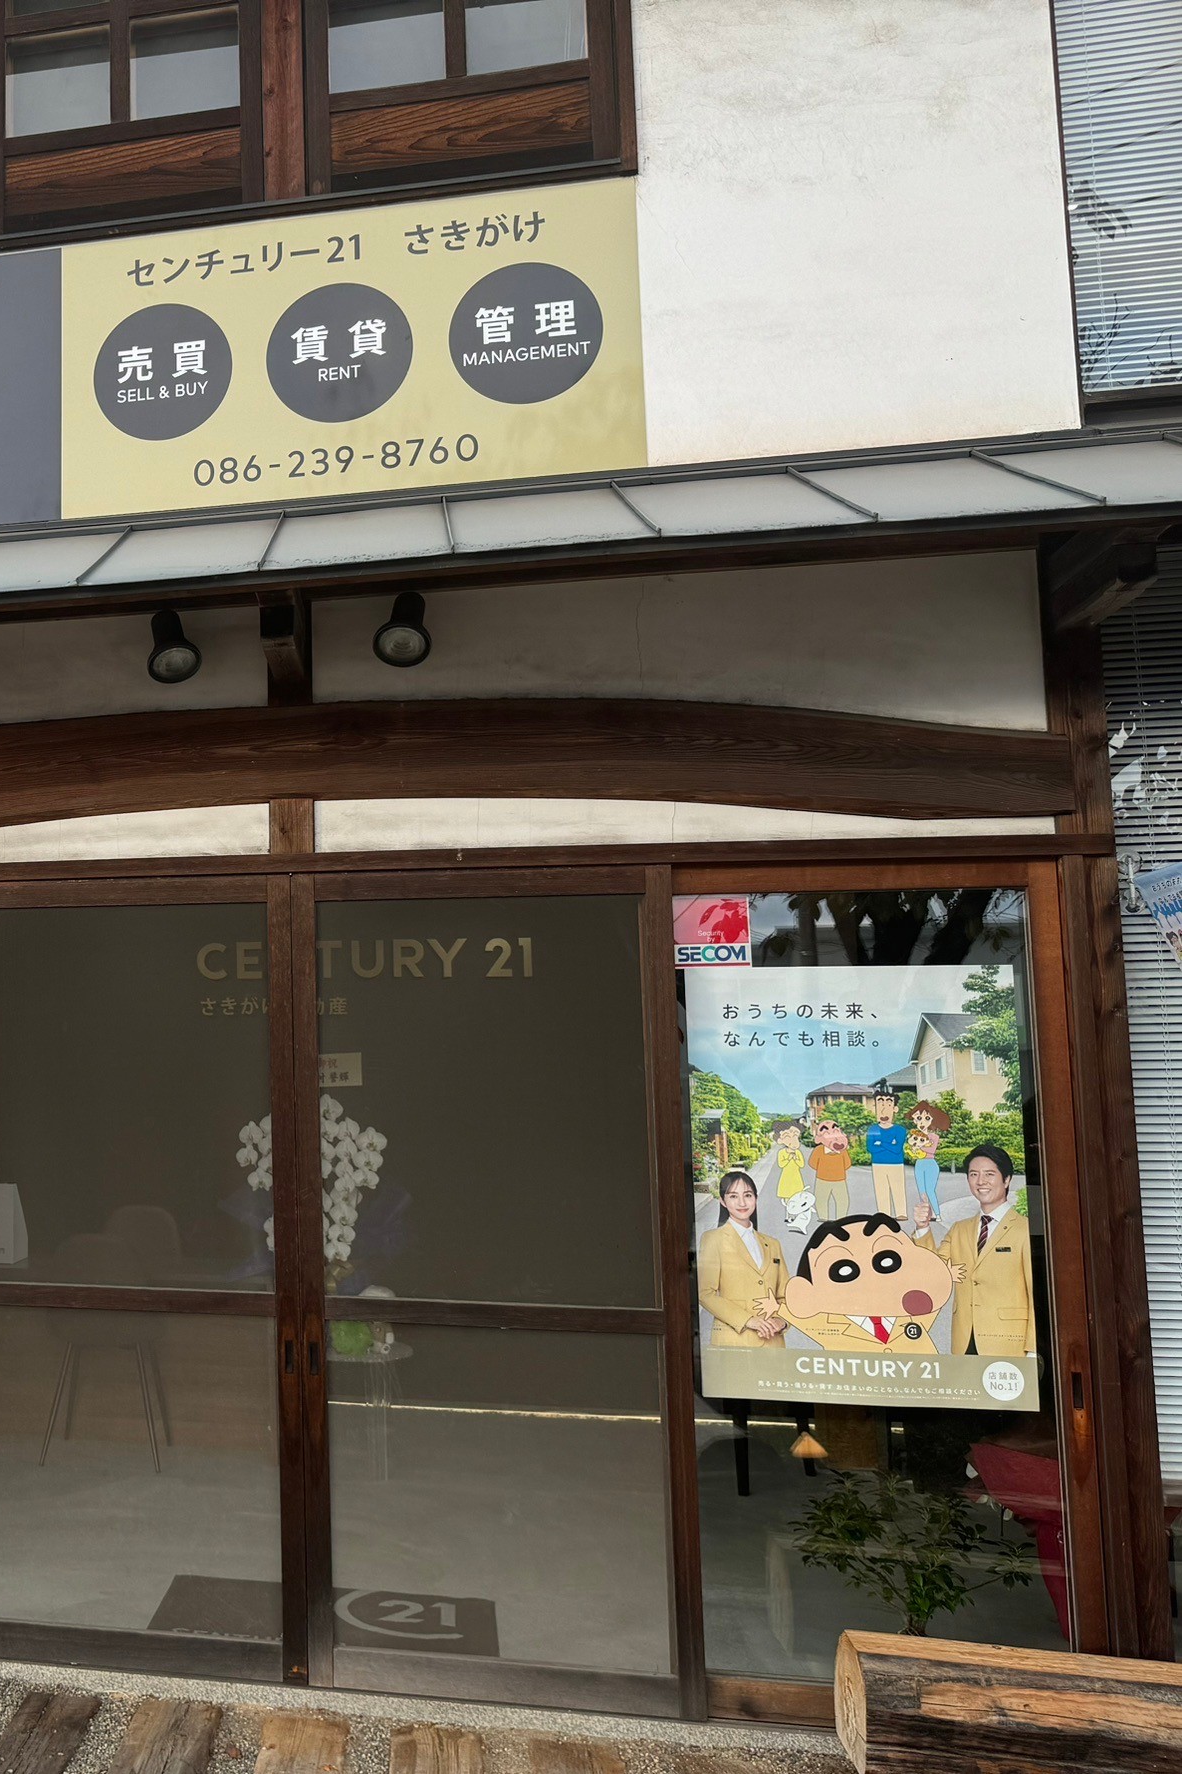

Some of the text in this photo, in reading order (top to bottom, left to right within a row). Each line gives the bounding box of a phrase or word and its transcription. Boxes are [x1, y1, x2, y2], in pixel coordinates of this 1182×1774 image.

[127, 212, 547, 288] センチュリー21 さきがけ
[474, 300, 579, 346] 管理
[291, 318, 388, 366] 賃貸
[463, 341, 592, 368] MANAGEMENT
[117, 339, 209, 381] 売買
[318, 364, 362, 383] RENT
[117, 381, 209, 405] SELL & BUY
[193, 433, 480, 488] 086-239-8760
[196, 937, 534, 981] CETURY 21
[677, 945, 747, 962] SECOM
[722, 1001, 880, 1021] おうちの未来、
[723, 1029, 882, 1049] なんでも相談。
[795, 1356, 941, 1379] CENTURY 21
[988, 1371, 1019, 1381] 店舗数
